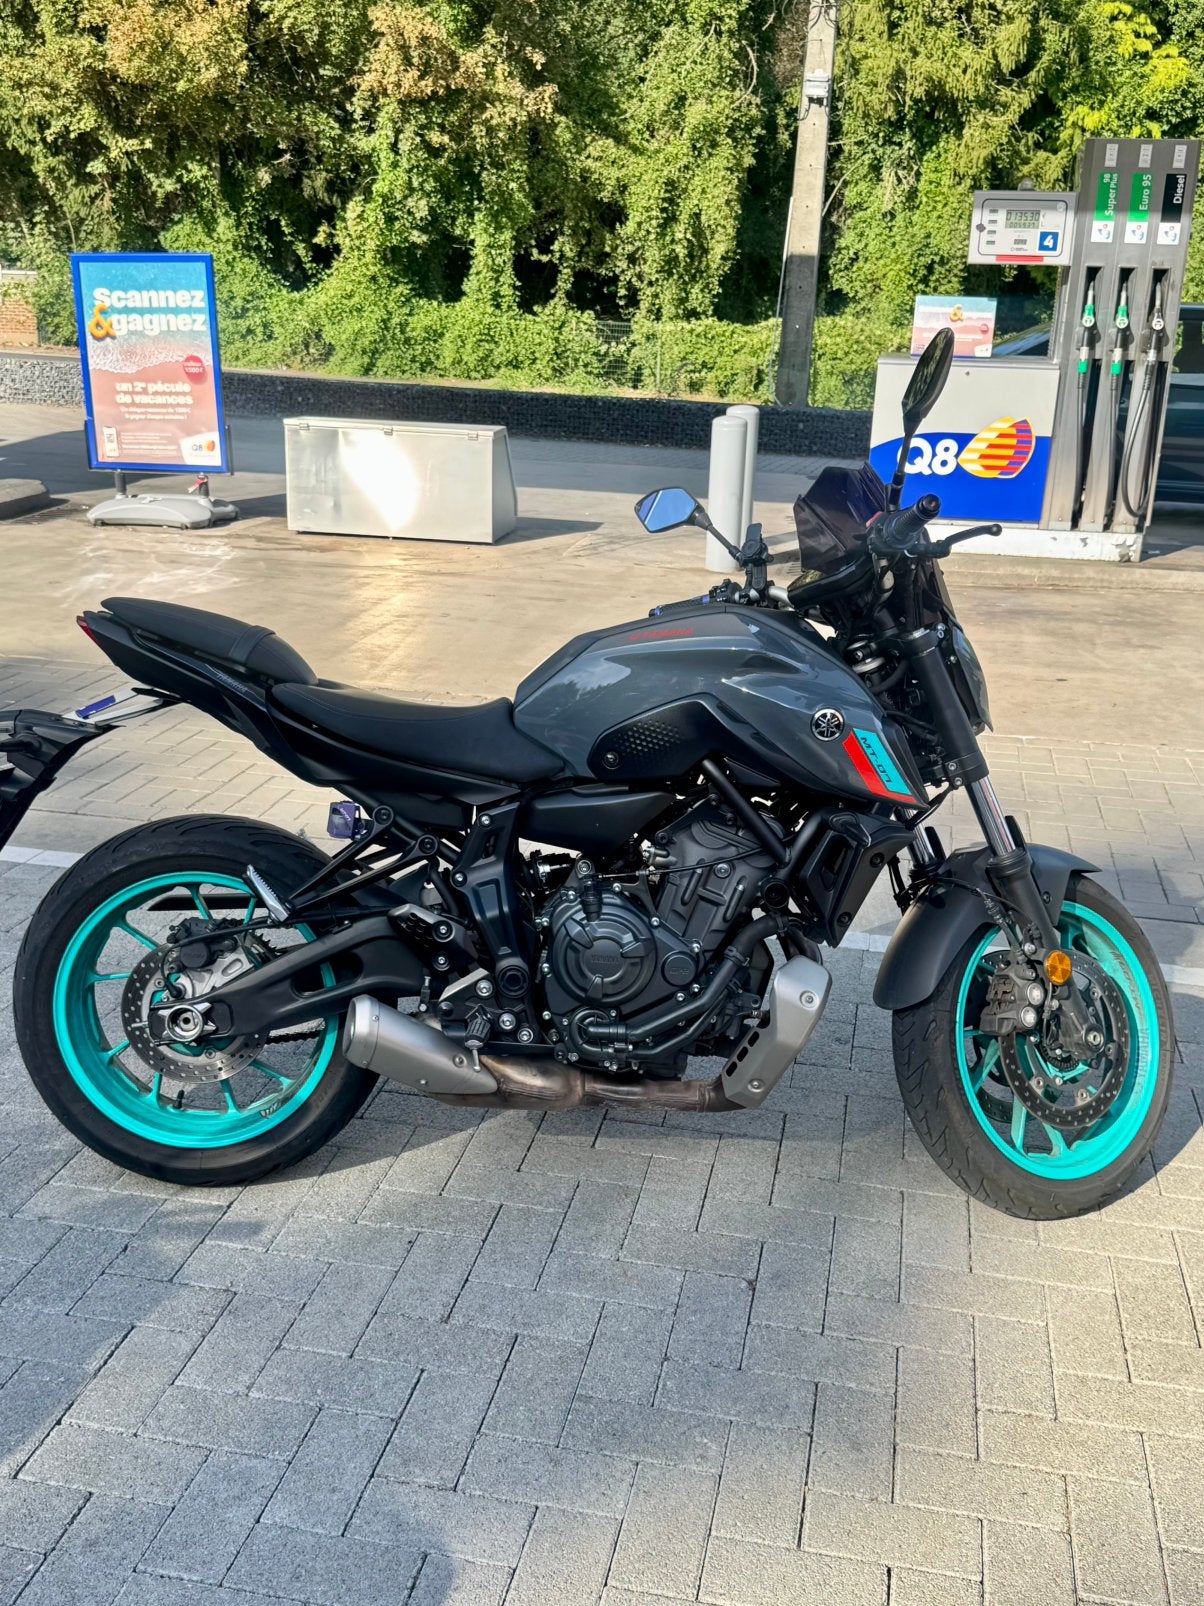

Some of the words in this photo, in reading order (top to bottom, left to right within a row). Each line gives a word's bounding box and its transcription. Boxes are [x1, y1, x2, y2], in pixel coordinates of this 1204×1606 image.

[1103, 173, 1111, 183] 98
[1109, 173, 1118, 188] Plus
[1142, 173, 1152, 187] 95
[1138, 189, 1150, 210] Euro
[1172, 175, 1185, 204] Diesel
[1104, 189, 1117, 216] Super
[1043, 234, 1054, 249] 4
[93, 287, 205, 308] Scannez
[89, 304, 117, 339] &
[112, 313, 207, 336] gagnez
[115, 382, 133, 392] un
[115, 393, 132, 404] de
[133, 394, 194, 405] vacances
[897, 437, 959, 476] Q8
[860, 737, 892, 783] MT-07
